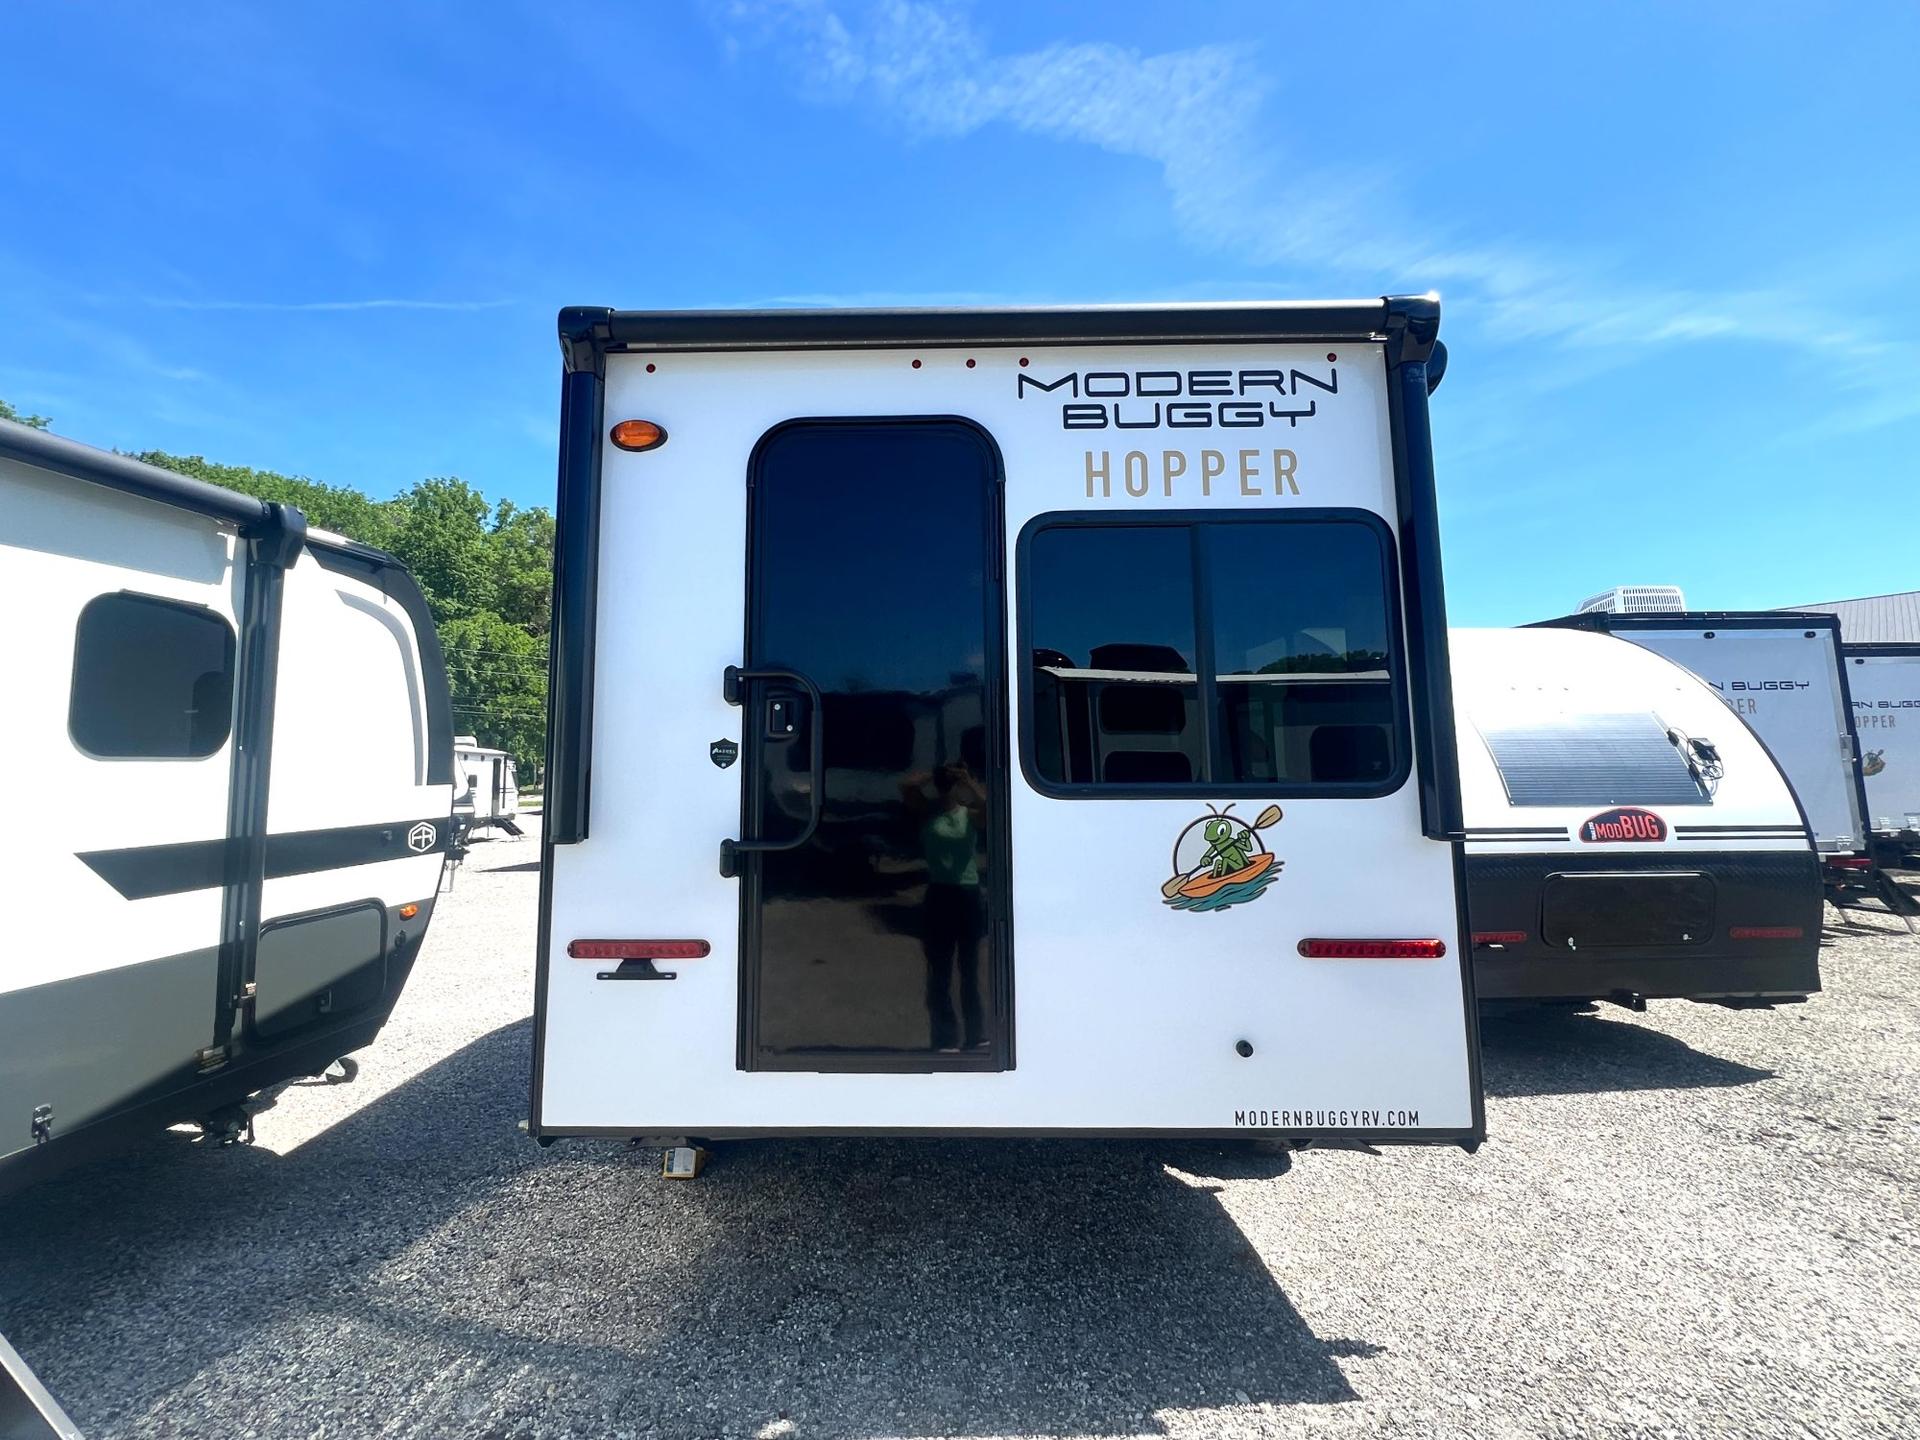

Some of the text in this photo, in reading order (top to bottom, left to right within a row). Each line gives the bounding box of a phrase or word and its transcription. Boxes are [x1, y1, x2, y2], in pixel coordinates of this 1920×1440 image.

[1018, 368, 1337, 399] MODERN
[1063, 400, 1316, 429] BUGGY
[1085, 449, 1301, 498] HOPPER
[1732, 680, 1810, 691] BUGGY
[1878, 700, 1920, 708] BUGG
[1854, 715, 1896, 728] OPPER
[1235, 1110, 1419, 1126] MODERNBUGGYRV.COM
